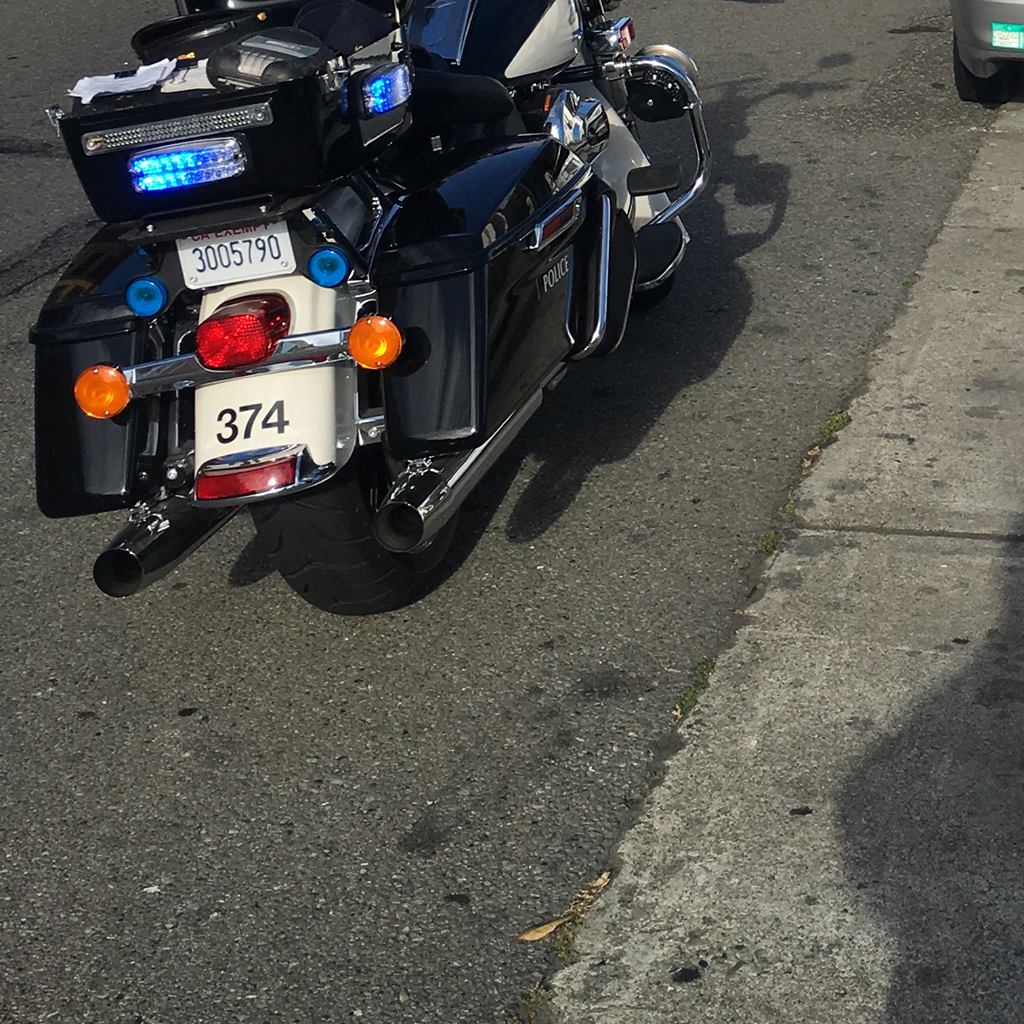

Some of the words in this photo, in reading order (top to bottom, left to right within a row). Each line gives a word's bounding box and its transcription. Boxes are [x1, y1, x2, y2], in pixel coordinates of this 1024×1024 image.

[192, 234, 282, 273] 3005790
[542, 255, 570, 293] POLICE
[216, 400, 290, 445] 374
